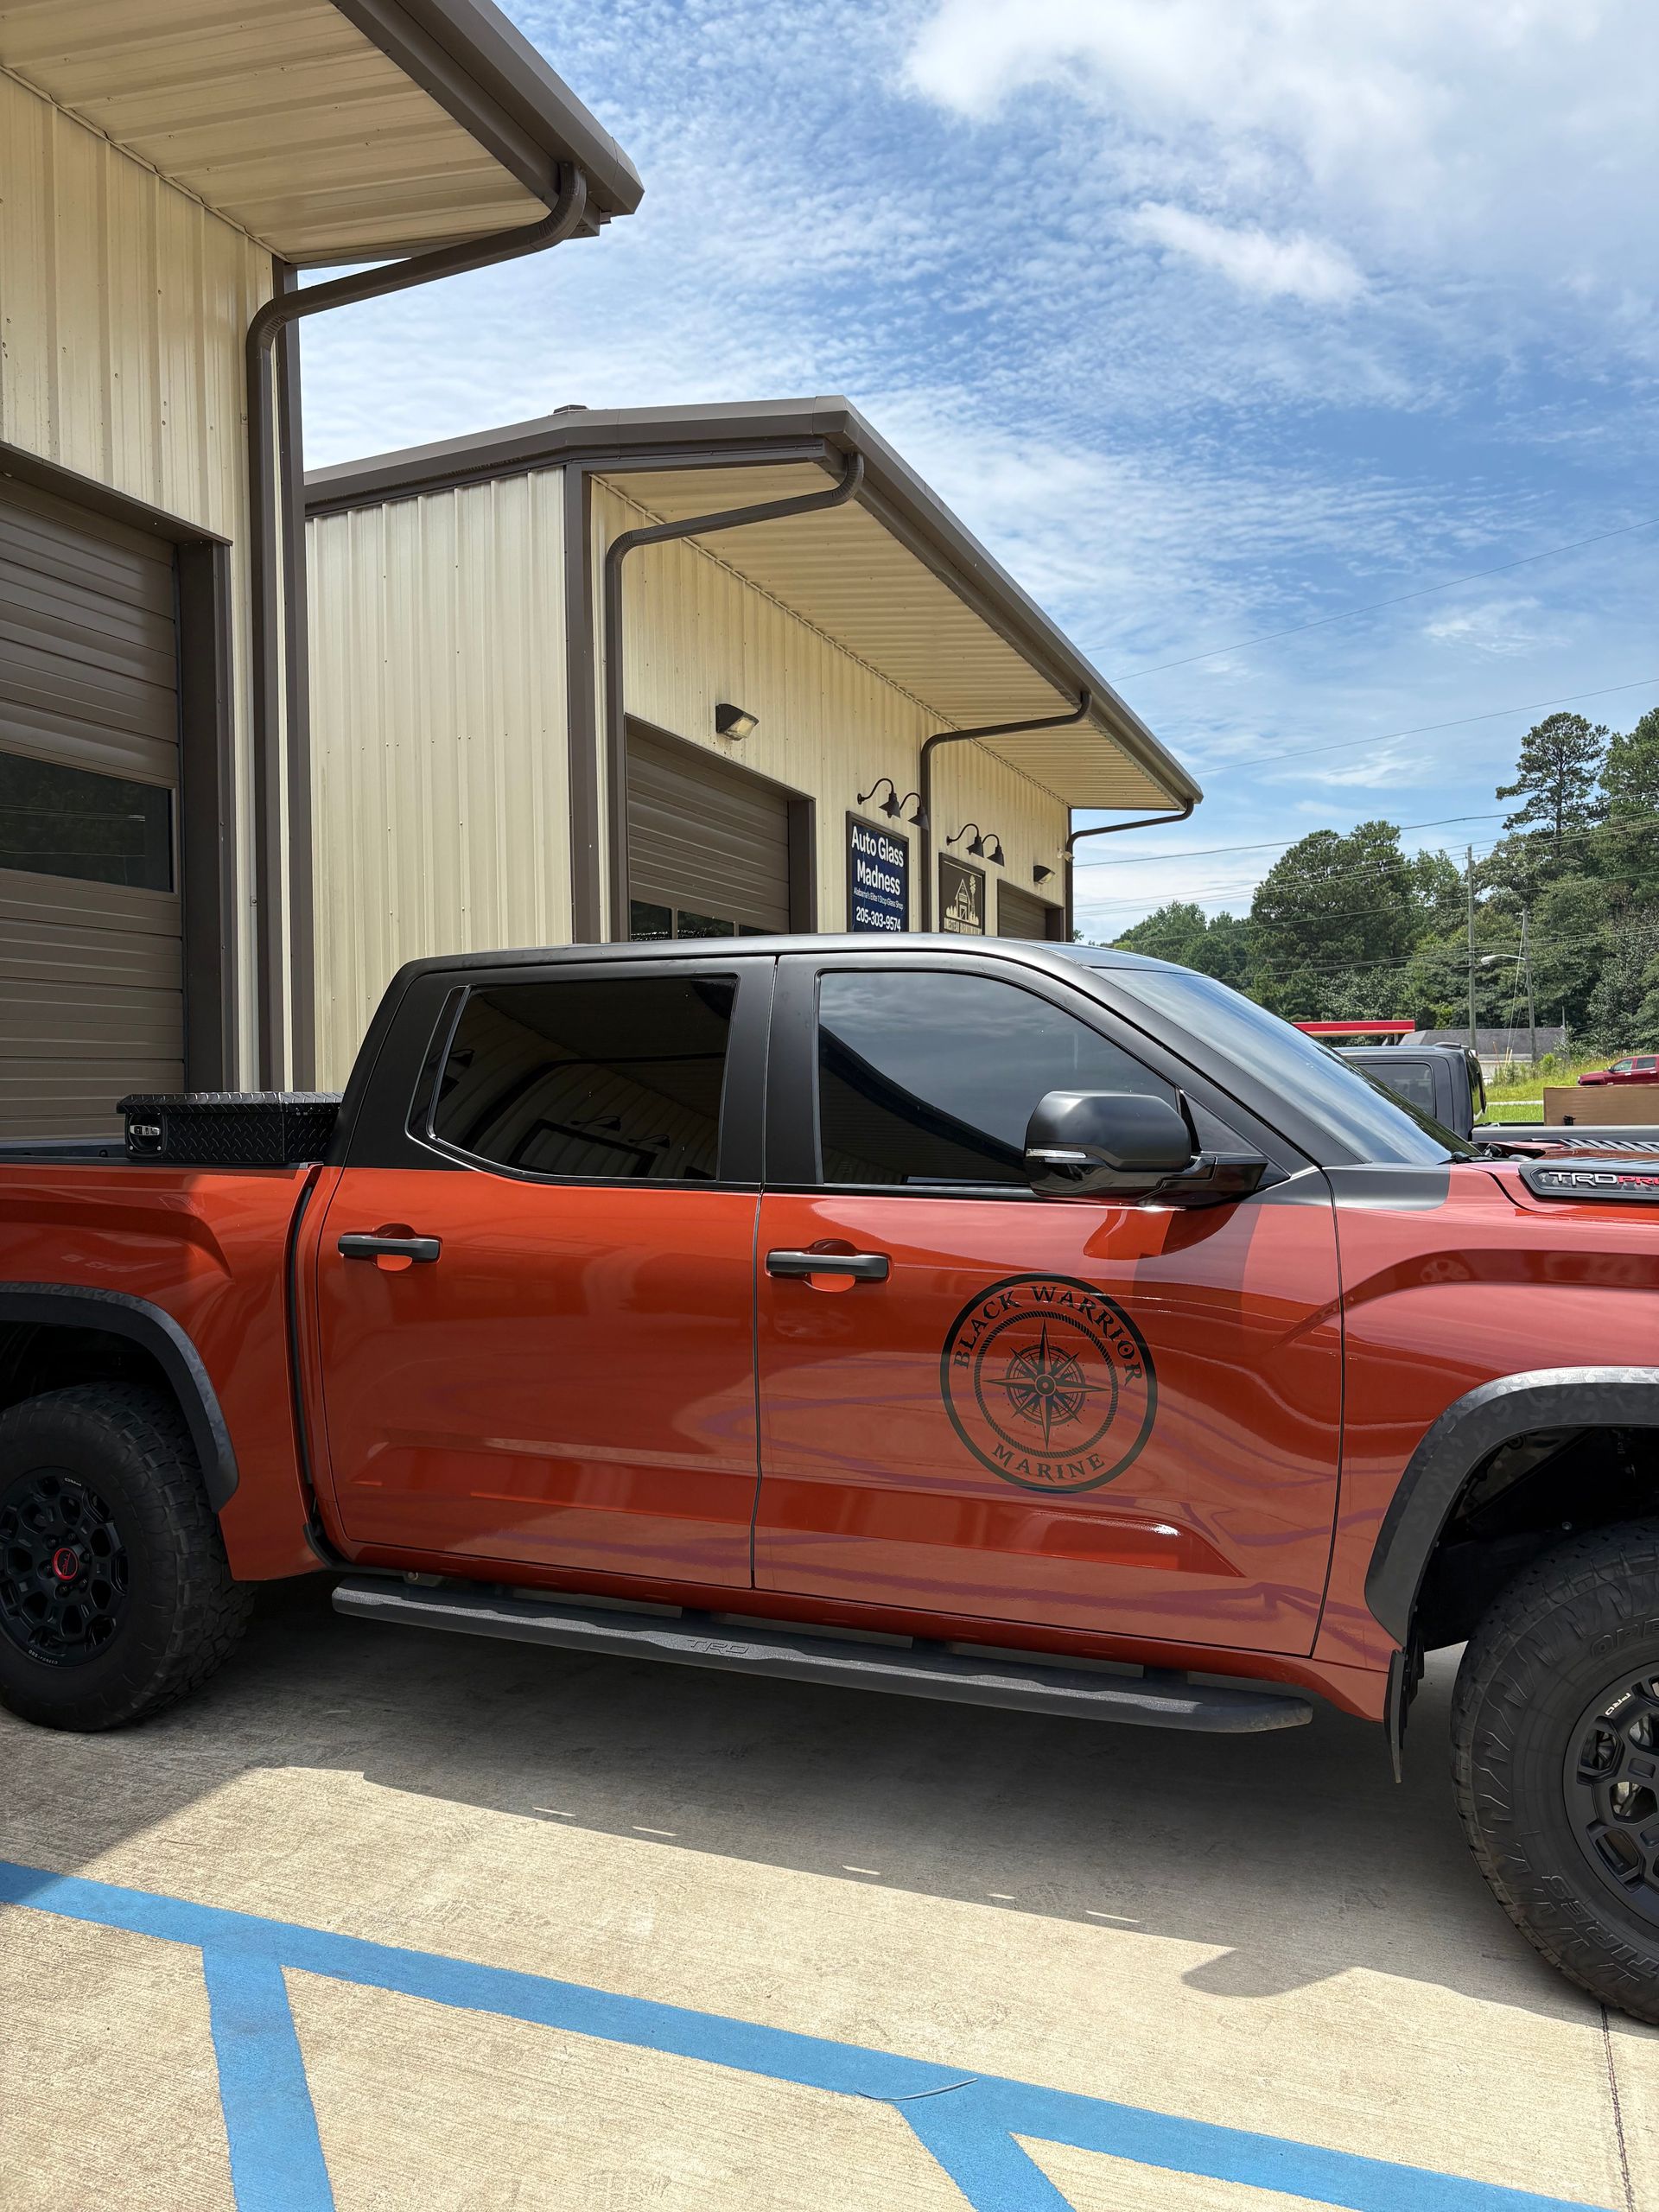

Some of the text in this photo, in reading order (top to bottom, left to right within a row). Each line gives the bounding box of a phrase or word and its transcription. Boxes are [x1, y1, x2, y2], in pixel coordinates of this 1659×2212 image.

[851, 826, 904, 868] Auto Glass
[856, 859, 900, 896] Madness
[856, 906, 901, 932] 205-303-9574
[1548, 1172, 1617, 1186] TRD
[953, 1286, 1143, 1387] BLACK WARRIOR
[991, 1442, 1106, 1483] MARINE
[687, 1639, 750, 1655] TRD
[1605, 1693, 1631, 1716] PRO
[1541, 1875, 1659, 1978] TIRES
